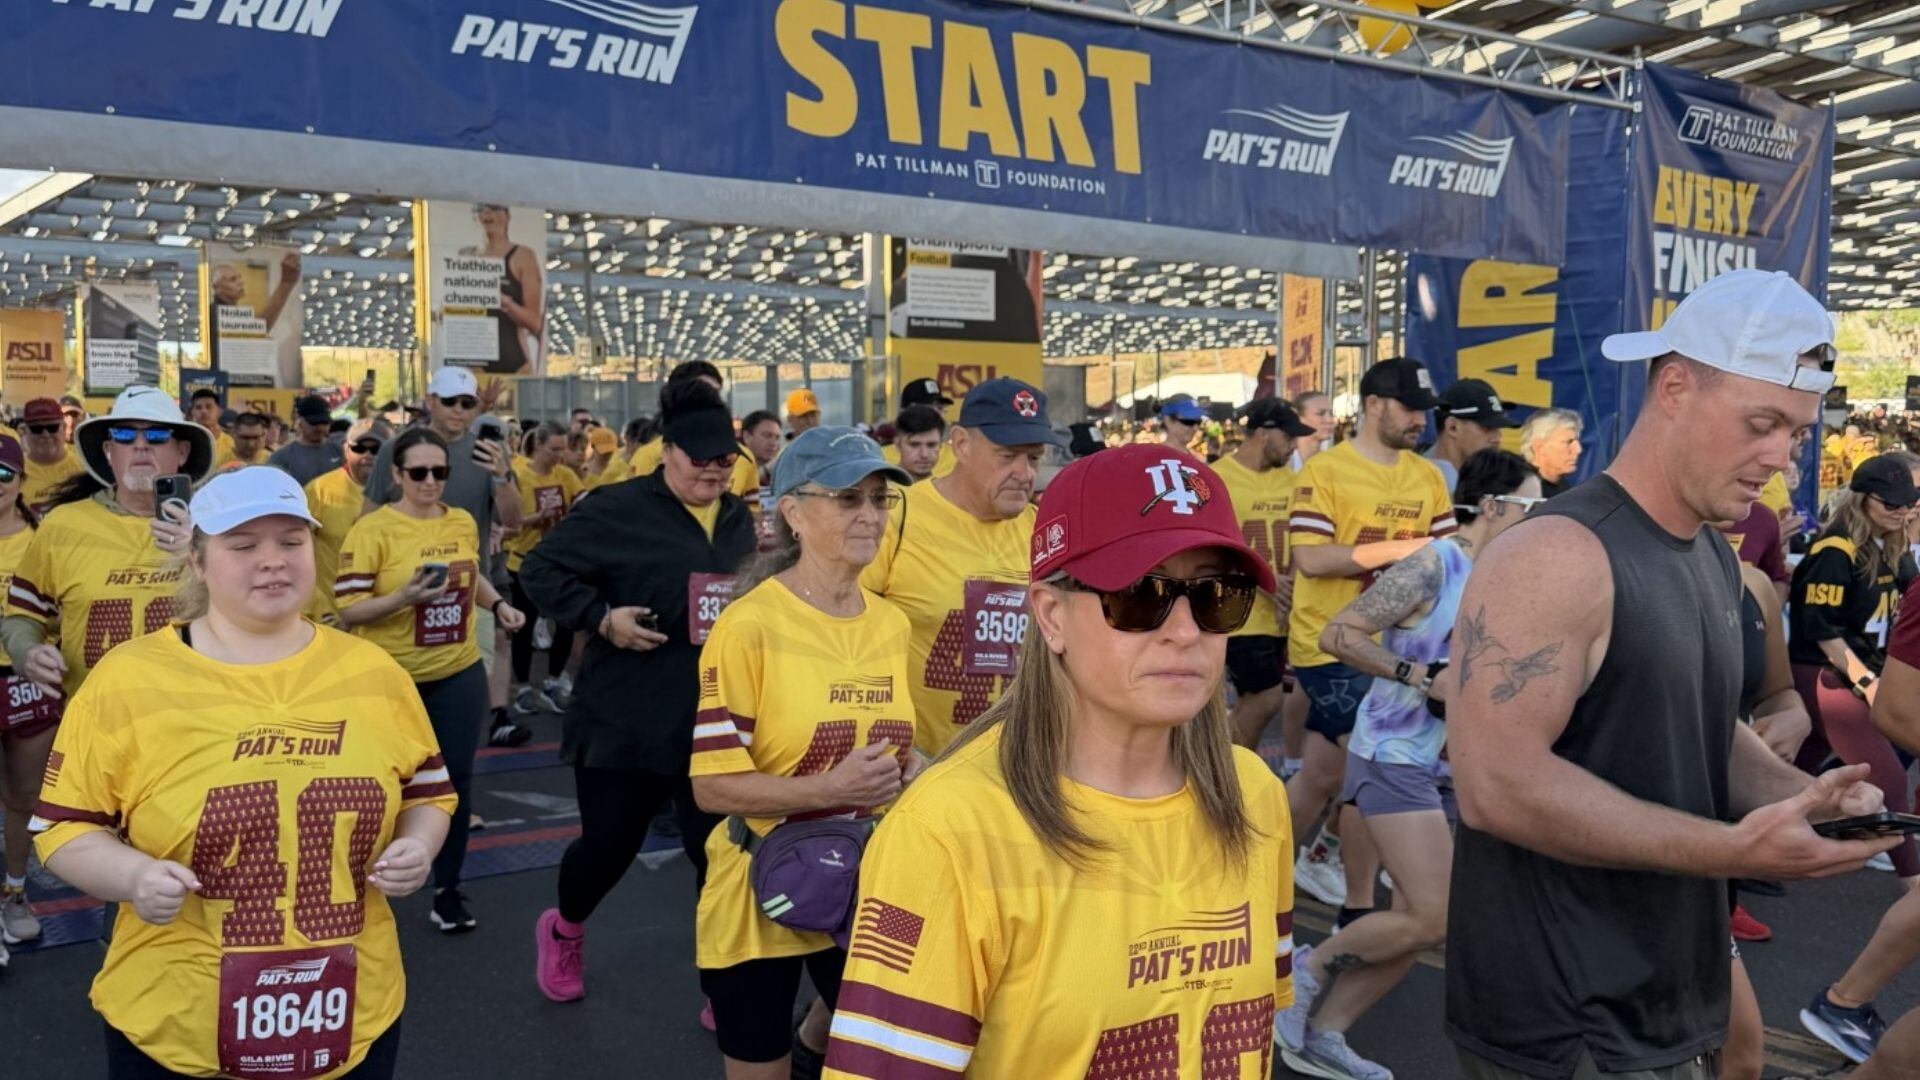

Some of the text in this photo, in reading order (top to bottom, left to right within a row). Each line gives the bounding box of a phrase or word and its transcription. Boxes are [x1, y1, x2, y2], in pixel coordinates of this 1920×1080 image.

[451, 14, 684, 85] PAT'S RUN
[774, 0, 1151, 174] START
[1714, 111, 1799, 142] PAT TILLMAN
[1203, 129, 1337, 177] PAT'S RUN
[1710, 129, 1796, 161] FOUNDATION
[855, 152, 888, 170] PAT
[895, 154, 969, 180] TILLMAN
[1006, 168, 1106, 196] FOUNDATION
[1389, 155, 1503, 198] PAT'S RUN
[1653, 164, 1760, 238] EVERY
[443, 258, 503, 273] Triathlon
[910, 253, 947, 265] Football
[444, 275, 498, 288] national
[444, 291, 498, 306] champs
[220, 308, 252, 317] Nobel
[220, 320, 265, 330] laureate
[6, 342, 53, 361] ASU
[91, 350, 128, 358] from the
[91, 360, 124, 369] ground
[105, 572, 149, 586] PAT'S
[1805, 582, 1844, 606] ASU
[424, 604, 462, 628] 3338
[698, 596, 729, 621] 33
[974, 609, 1029, 644] 3598
[829, 689, 893, 704] PAT'S RUN
[233, 735, 343, 762] PAT'S RUN
[191, 777, 388, 947] 40
[1148, 934, 1182, 952] ANNUAL
[1127, 937, 1251, 989] PAT'S RUN
[256, 972, 295, 987] PAT'S
[292, 970, 322, 984] RUN
[232, 986, 348, 1041] 18649
[240, 1053, 295, 1063] GILA RIVER
